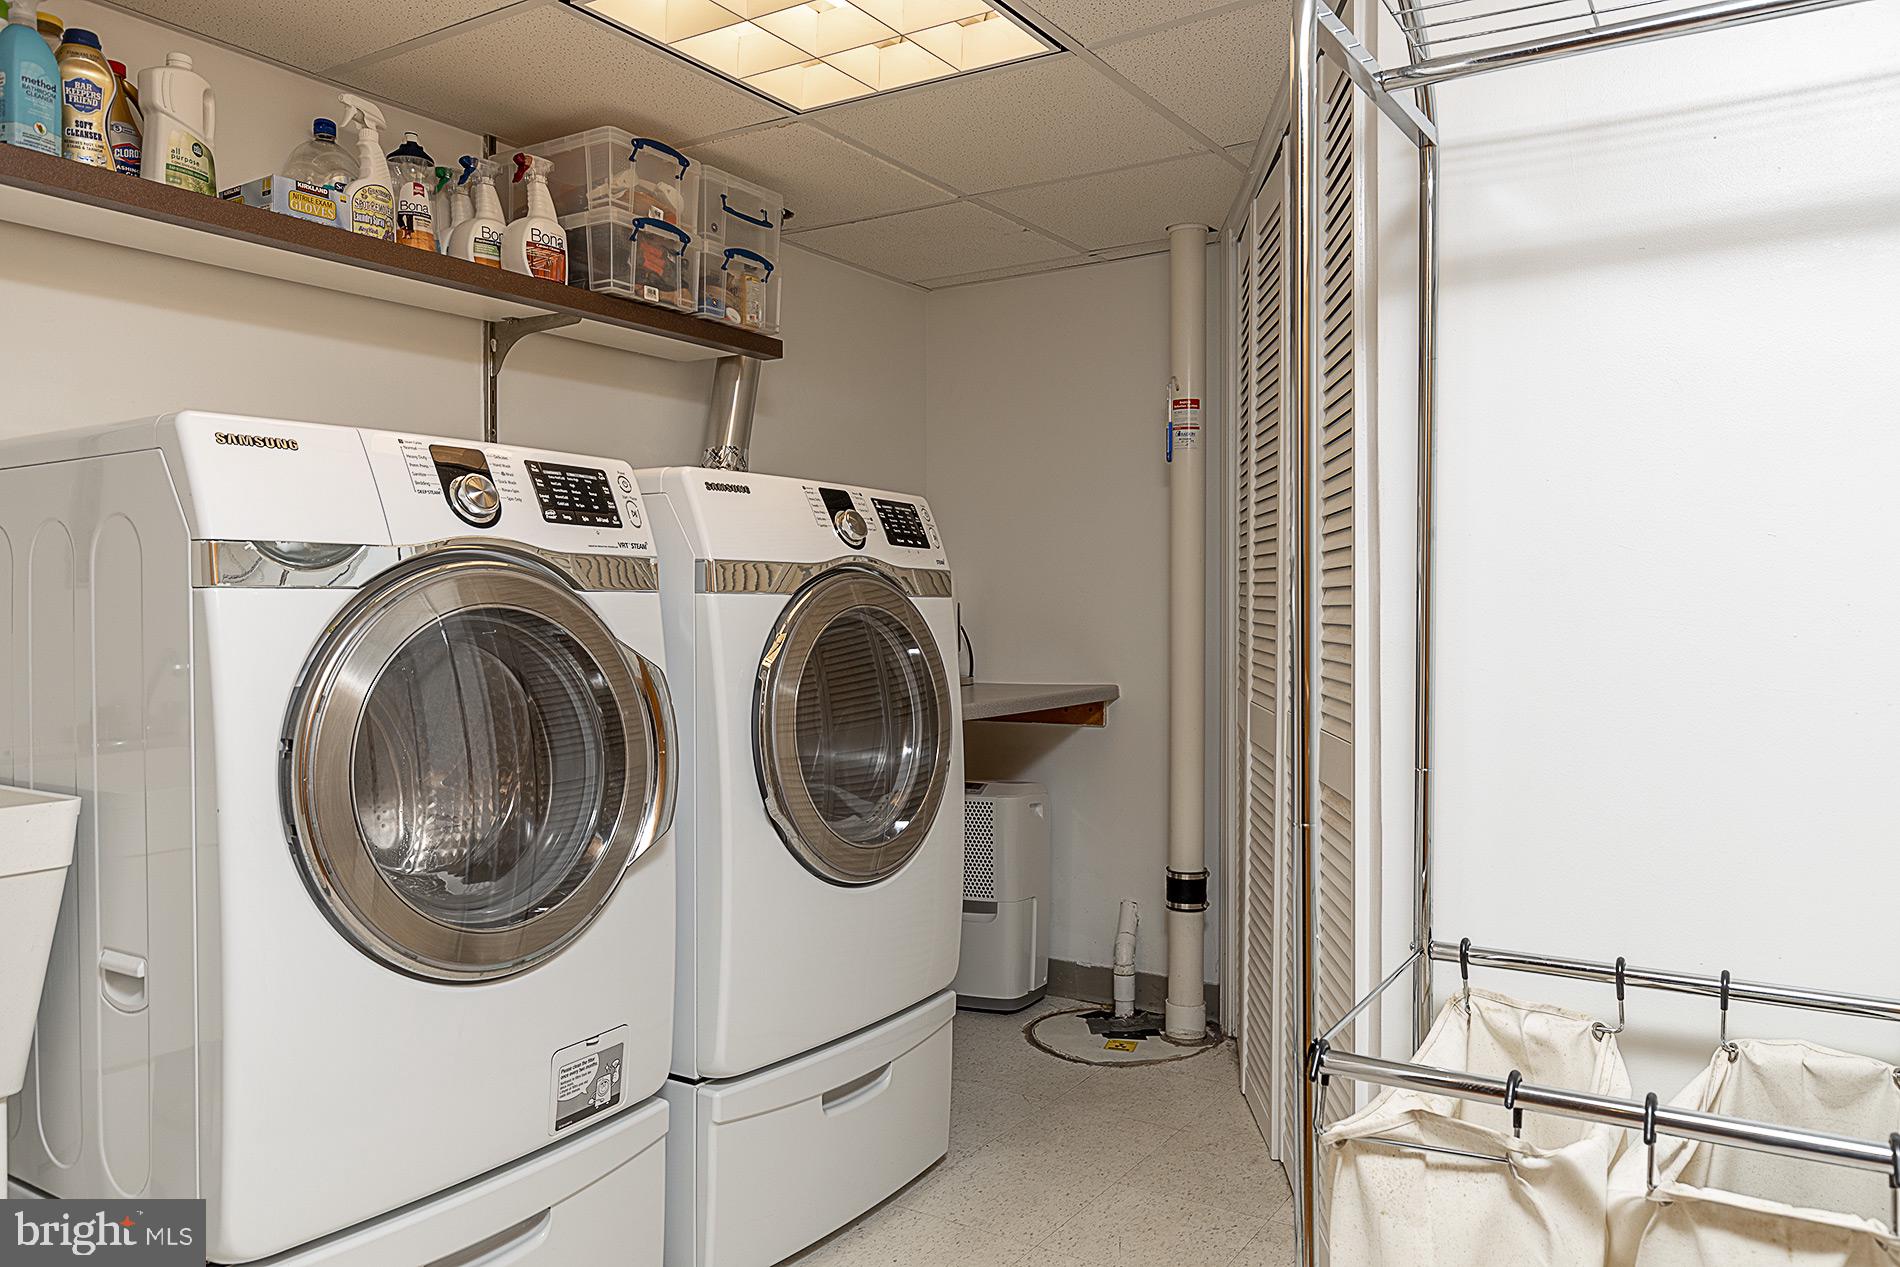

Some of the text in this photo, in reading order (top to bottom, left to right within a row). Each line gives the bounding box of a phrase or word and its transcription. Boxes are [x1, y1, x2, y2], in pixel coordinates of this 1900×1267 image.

[22, 76, 57, 93] method
[75, 82, 92, 92] BAR
[66, 87, 102, 100] KEEPERS
[69, 95, 98, 107] FRIEND
[75, 119, 93, 131] SOFT
[66, 128, 102, 141] CLEANSER
[114, 148, 141, 159] CLORO
[171, 147, 181, 155] all
[171, 154, 200, 168] purpose
[297, 181, 329, 194] KIRKLAND
[293, 192, 333, 209] NITRILE EXAM
[400, 200, 429, 214] Bona
[291, 200, 336, 219] GLOVES
[531, 228, 565, 249] Bona
[215, 431, 299, 451] SAMSUNG
[705, 481, 751, 495] SAMSUNG
[617, 542, 629, 550] VRT
[630, 543, 648, 551] STEAM
